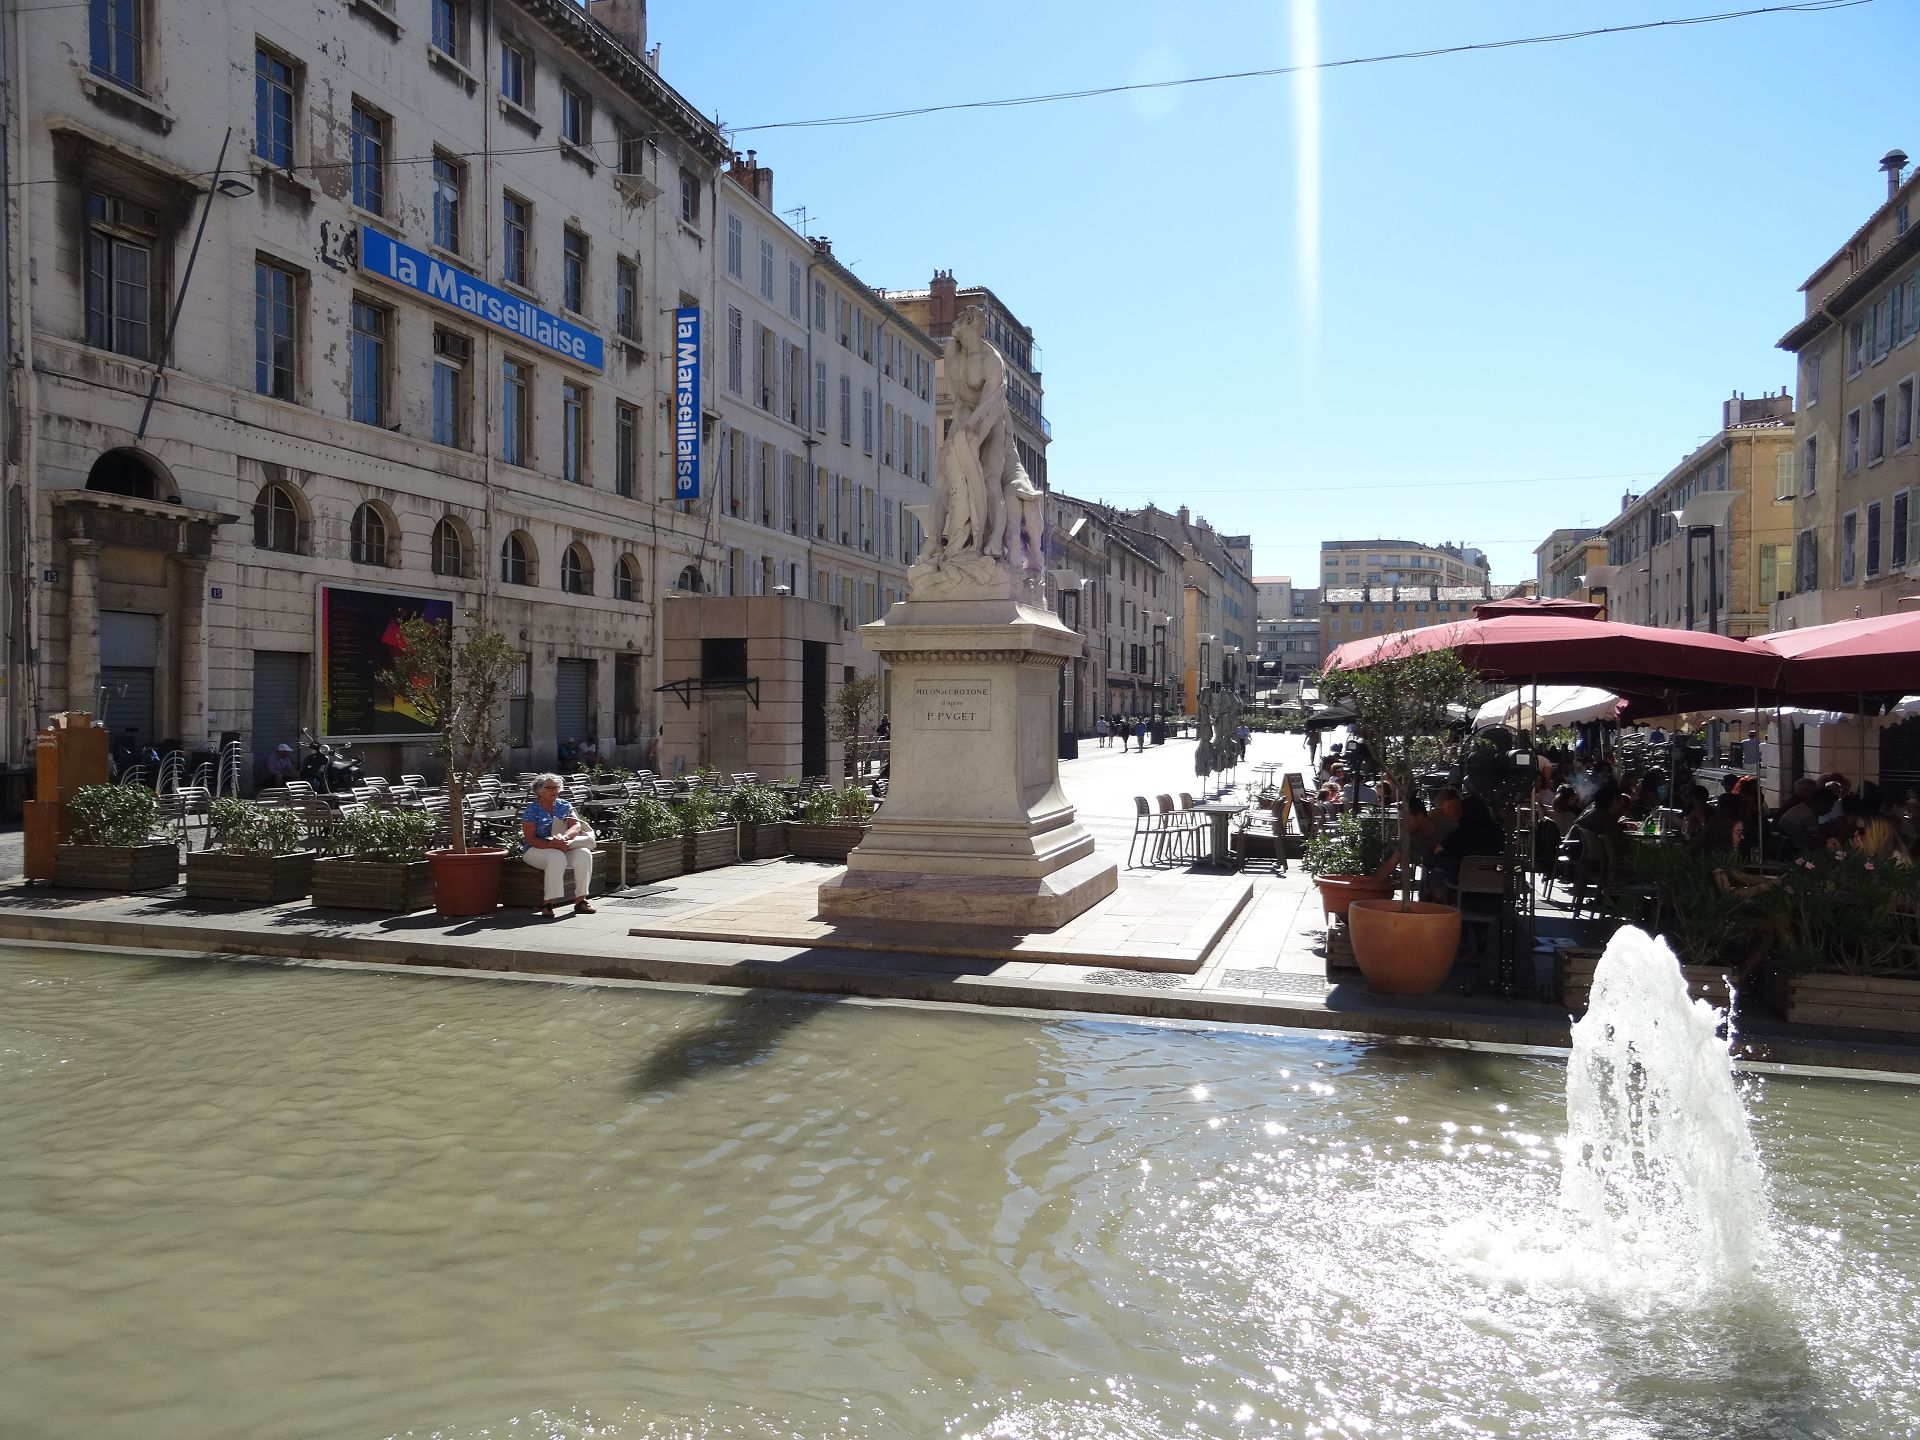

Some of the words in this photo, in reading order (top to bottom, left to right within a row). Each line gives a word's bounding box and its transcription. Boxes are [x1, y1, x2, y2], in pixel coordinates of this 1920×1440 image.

[389, 242, 418, 287] la
[427, 261, 586, 360] Marseillaise
[678, 316, 697, 339] la
[677, 342, 697, 491] Marseillaise
[916, 688, 941, 696] MILON
[948, 688, 989, 696] CROTONE
